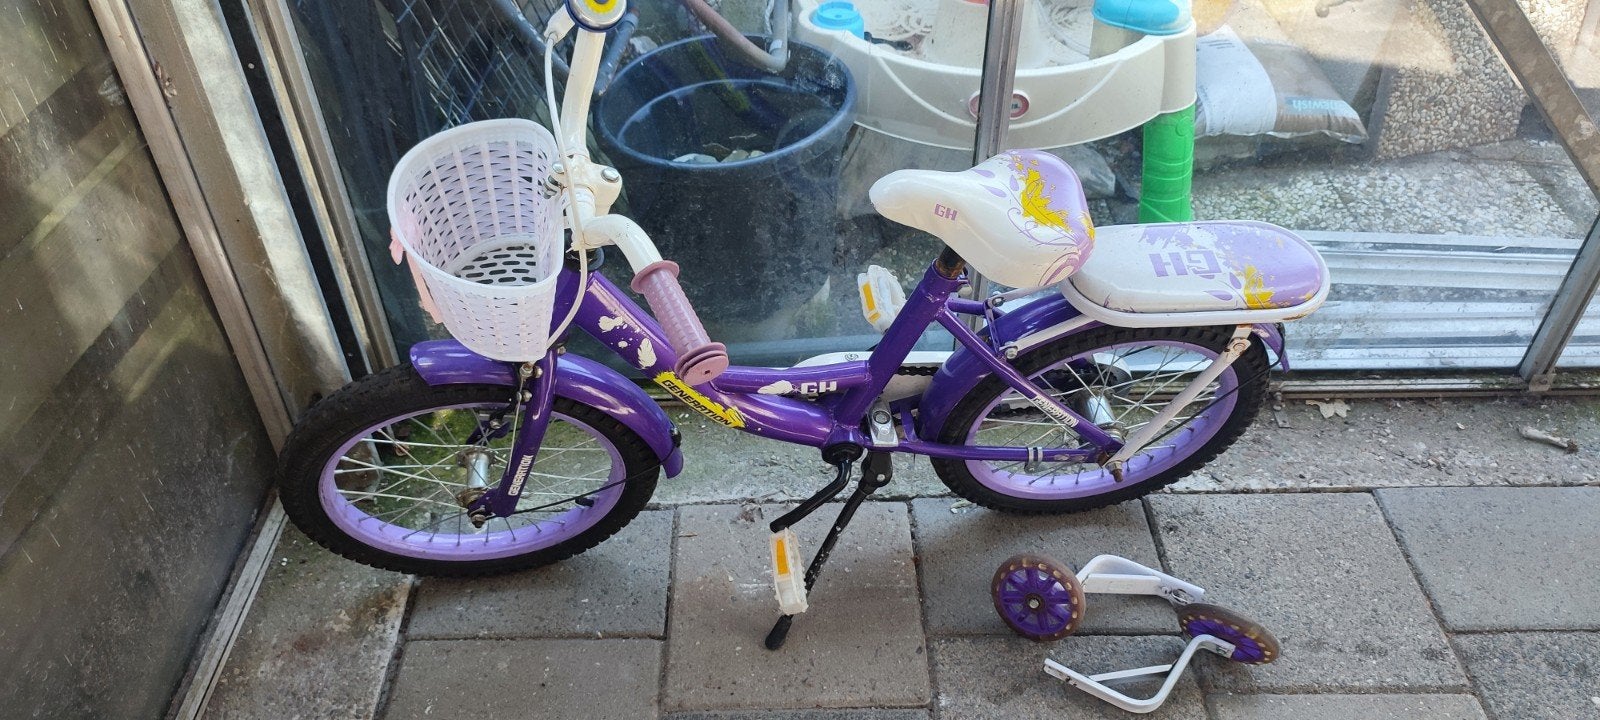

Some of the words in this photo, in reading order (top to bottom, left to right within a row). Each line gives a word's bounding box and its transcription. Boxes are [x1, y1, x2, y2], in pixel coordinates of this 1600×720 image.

[934, 203, 958, 221] GH
[1148, 249, 1222, 277] GH
[661, 379, 732, 426] GENERATION
[800, 380, 838, 396] GH
[1030, 395, 1080, 428] GENERATION
[507, 454, 534, 496] GENERATION
